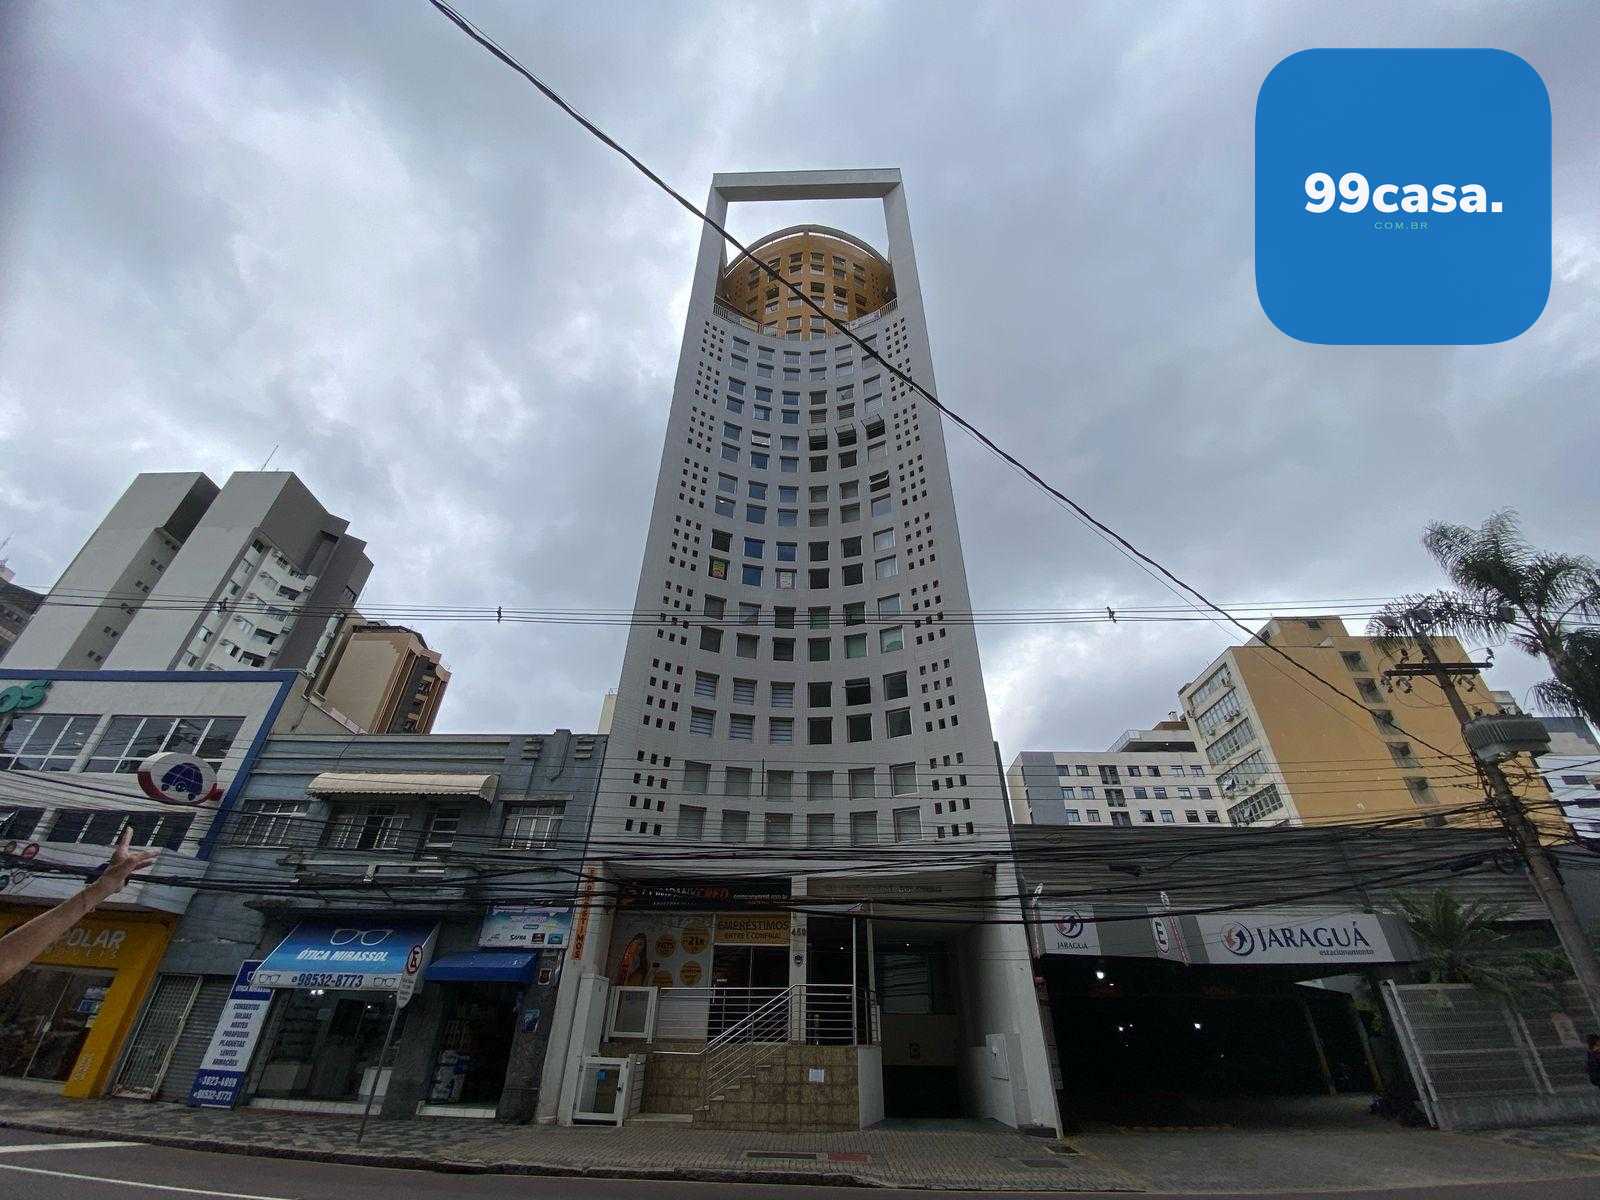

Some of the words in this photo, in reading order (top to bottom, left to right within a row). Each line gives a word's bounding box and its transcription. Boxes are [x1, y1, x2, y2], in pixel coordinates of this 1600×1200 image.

[1257, 921, 1370, 952] JARAGUÁ
[297, 949, 328, 960] ÓTICA
[329, 950, 389, 962] MIRASSOL
[297, 974, 364, 987] 98532-8773
